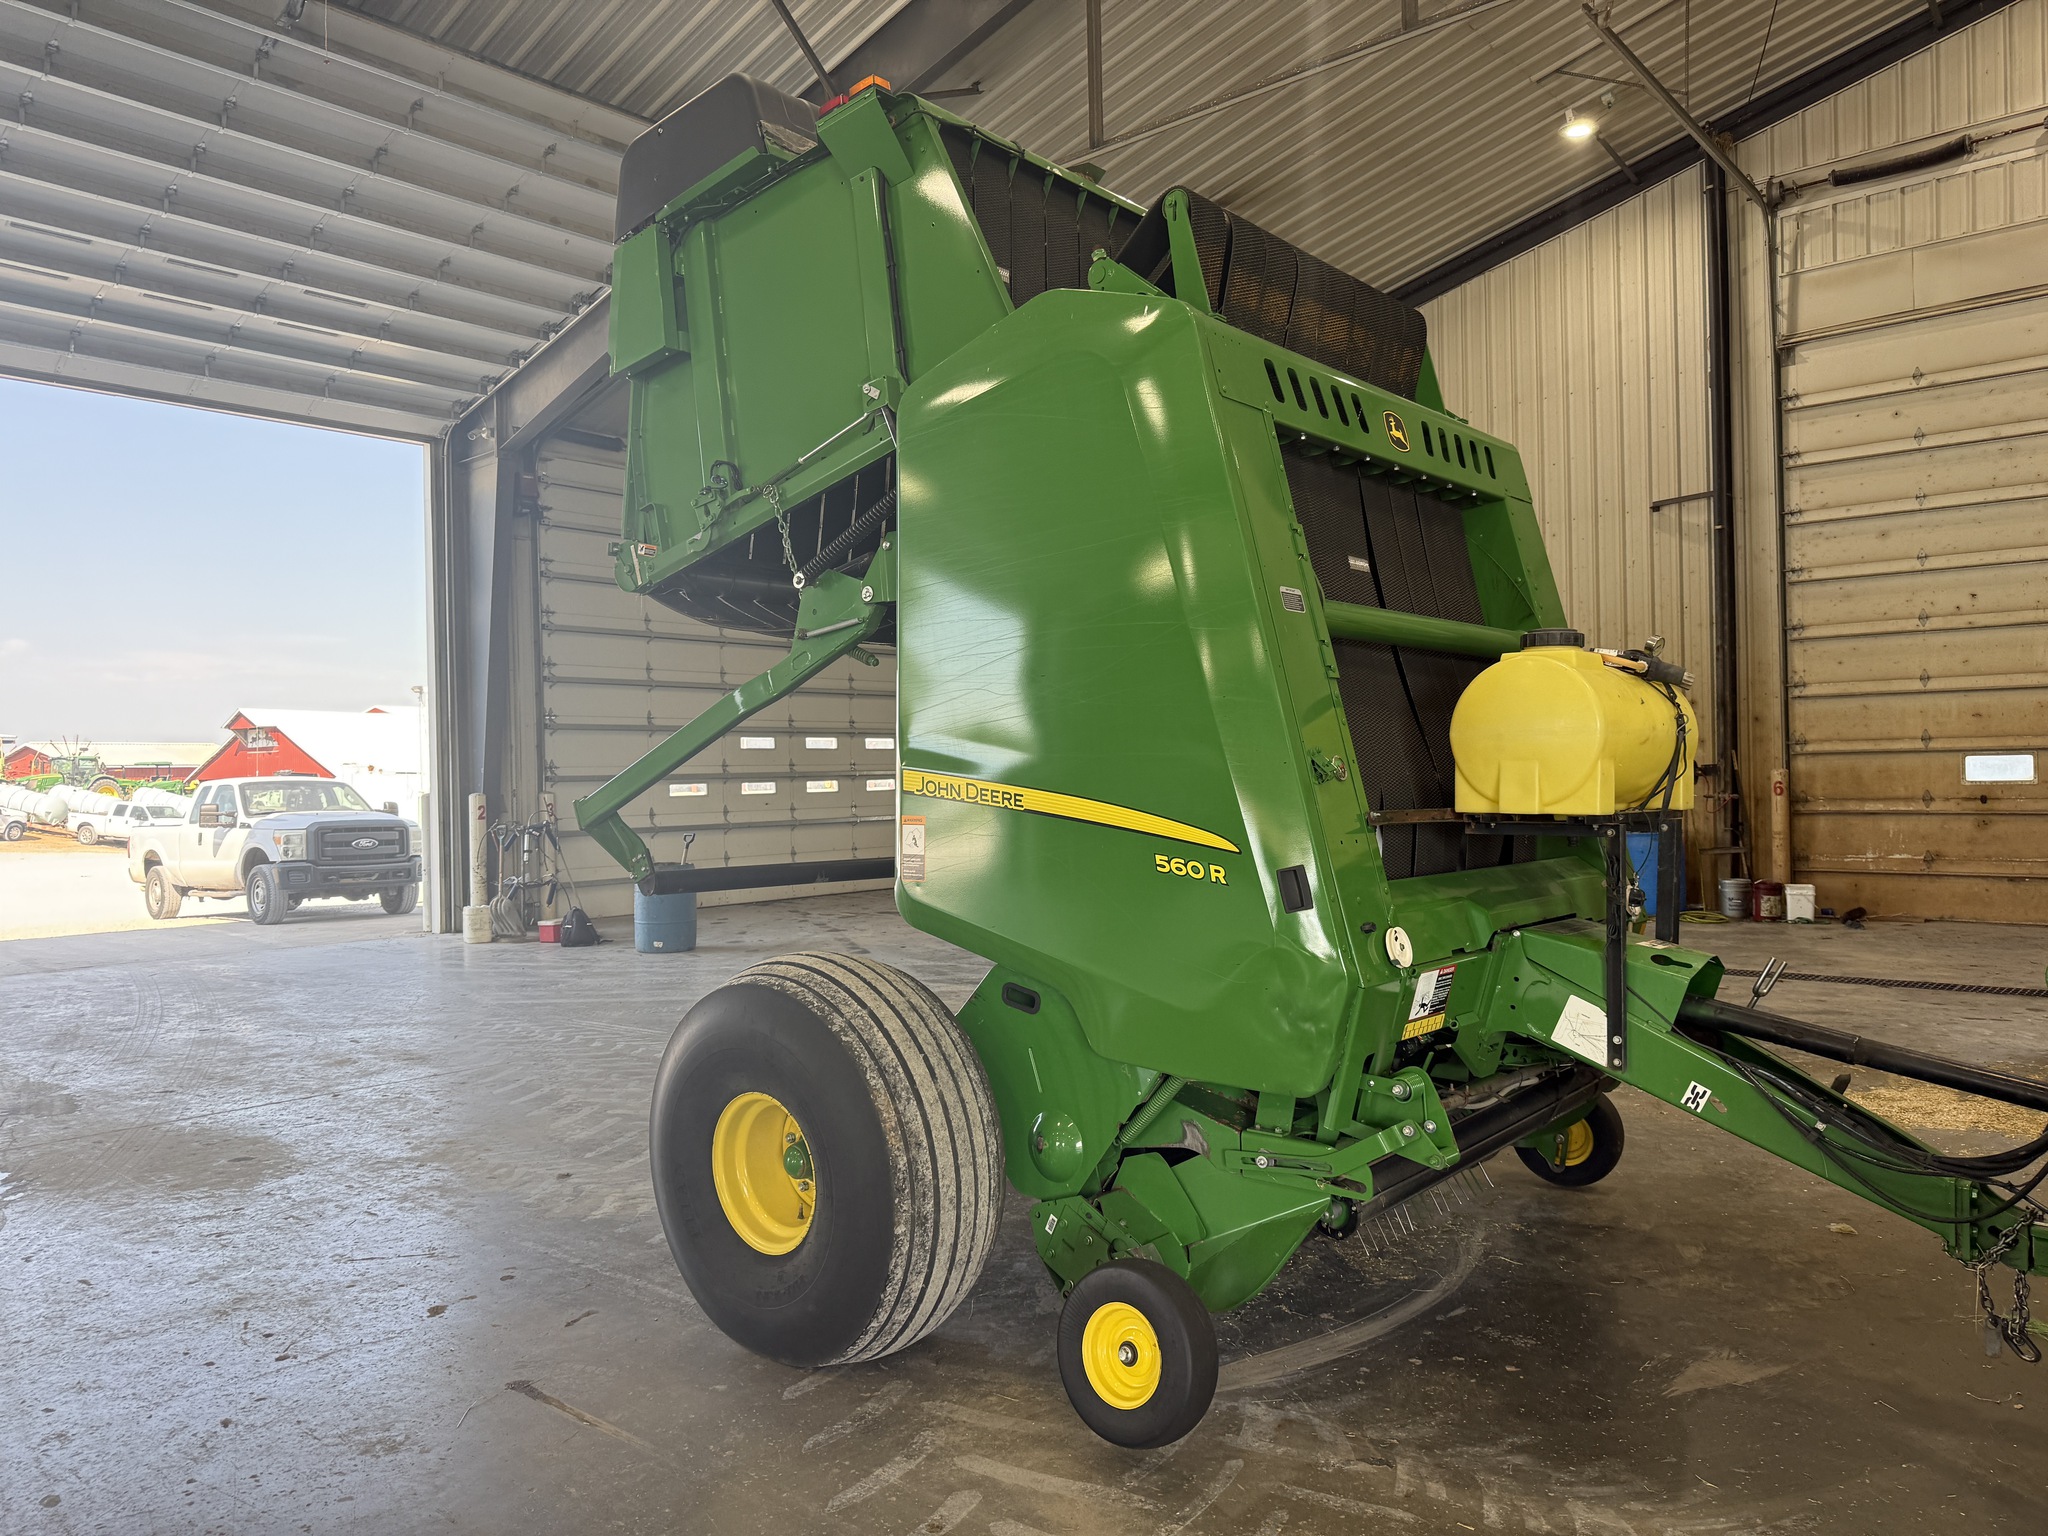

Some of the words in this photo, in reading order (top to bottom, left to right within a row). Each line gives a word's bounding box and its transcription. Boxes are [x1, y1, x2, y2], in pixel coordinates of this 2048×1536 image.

[916, 776, 961, 798] JOHN
[966, 782, 1024, 808] DEERE
[1773, 780, 1784, 796] 6
[477, 805, 486, 820] 2
[1154, 854, 1206, 880] 560
[1208, 863, 1228, 885] R
